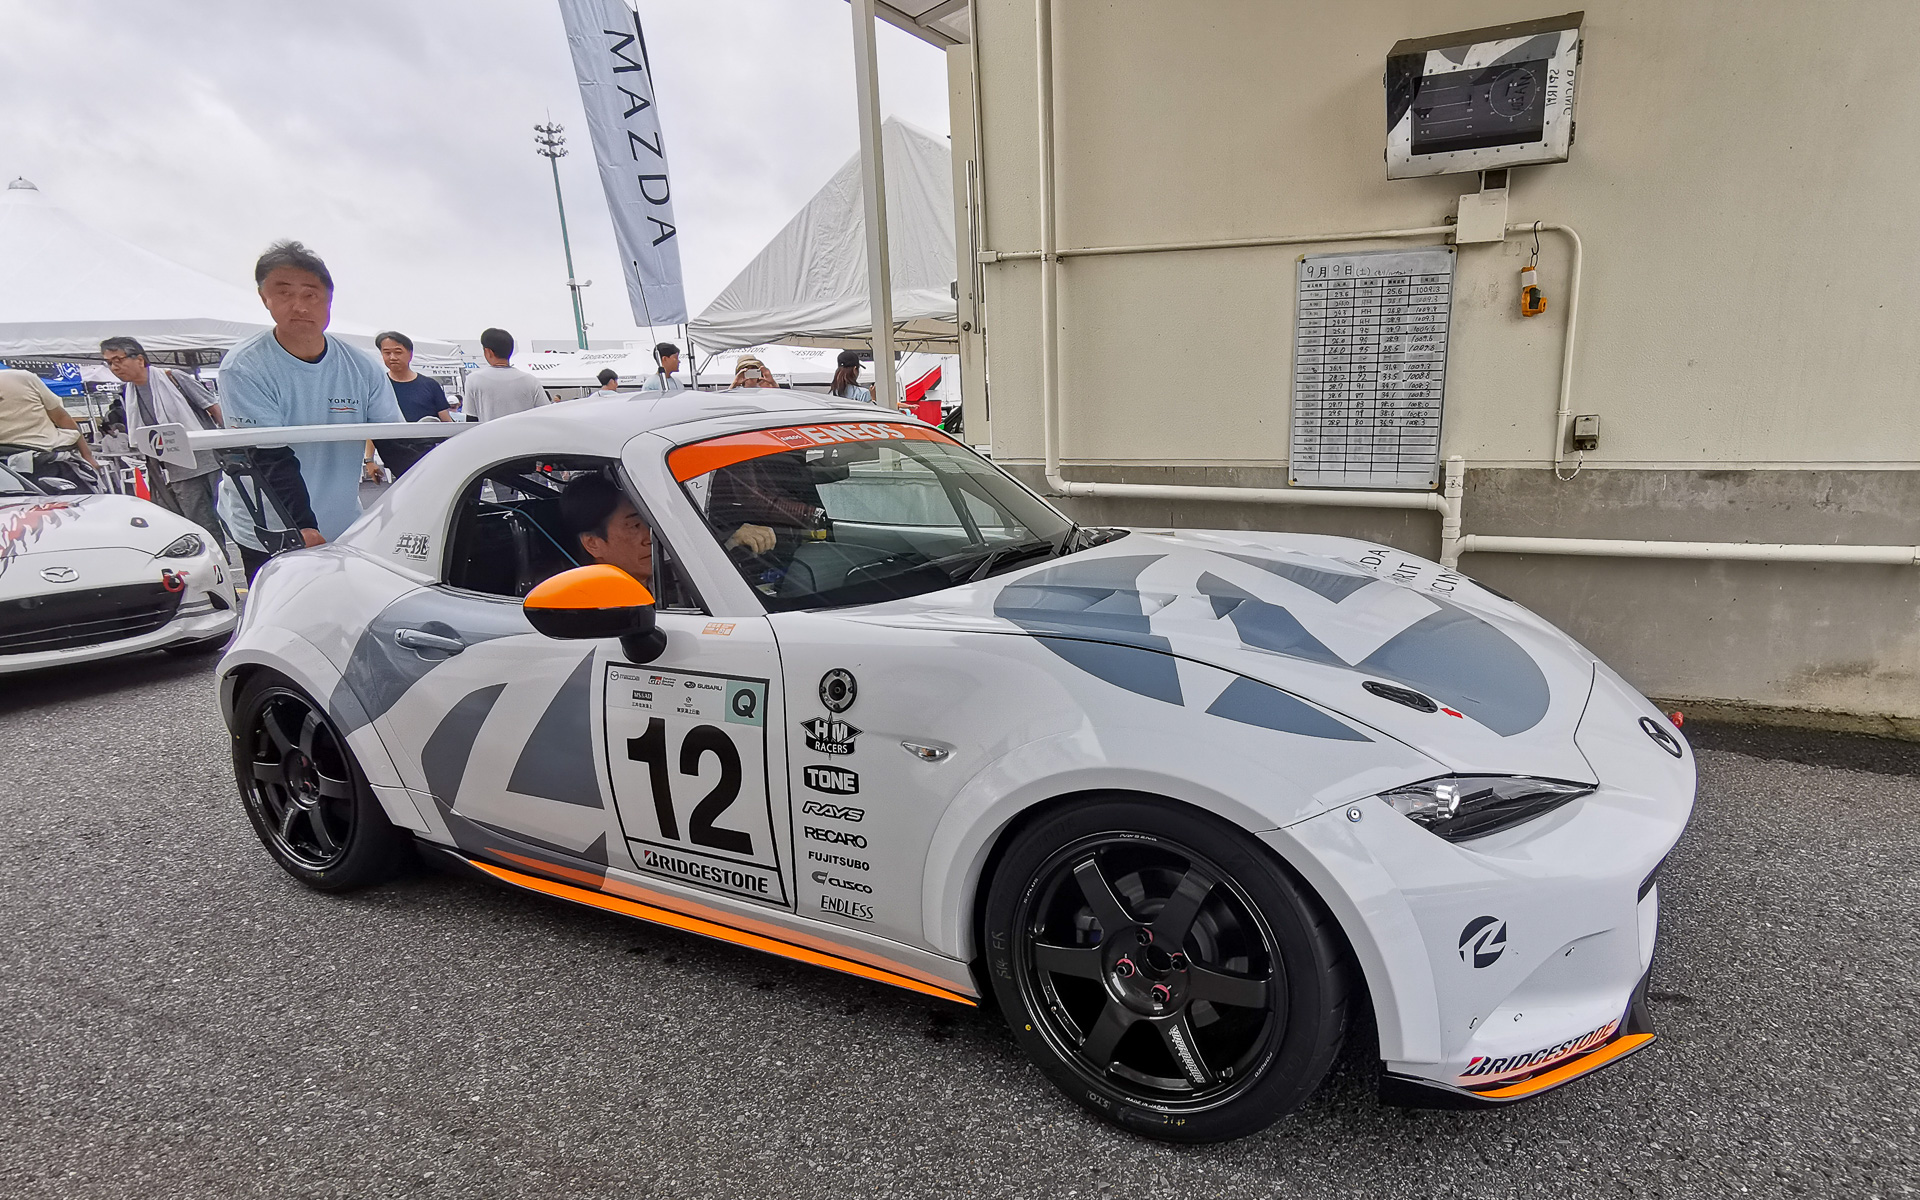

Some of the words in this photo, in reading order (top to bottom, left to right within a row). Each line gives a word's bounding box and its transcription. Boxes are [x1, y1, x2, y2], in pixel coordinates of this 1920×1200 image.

[603, 29, 676, 247] MAZDA
[801, 423, 905, 444] ENEOS
[697, 683, 723, 691] SUBARU
[732, 688, 755, 719] Q
[815, 741, 848, 753] RACERS
[627, 716, 754, 856] 12
[807, 768, 856, 792] TONE
[803, 802, 864, 821] RAYS
[804, 826, 867, 849] RECARO
[644, 850, 768, 893] BRIDGESTONE
[808, 851, 870, 871] FUJITSUBO
[821, 895, 874, 920] ENDLESS
[1459, 1018, 1617, 1077] BRIDGESTONE
